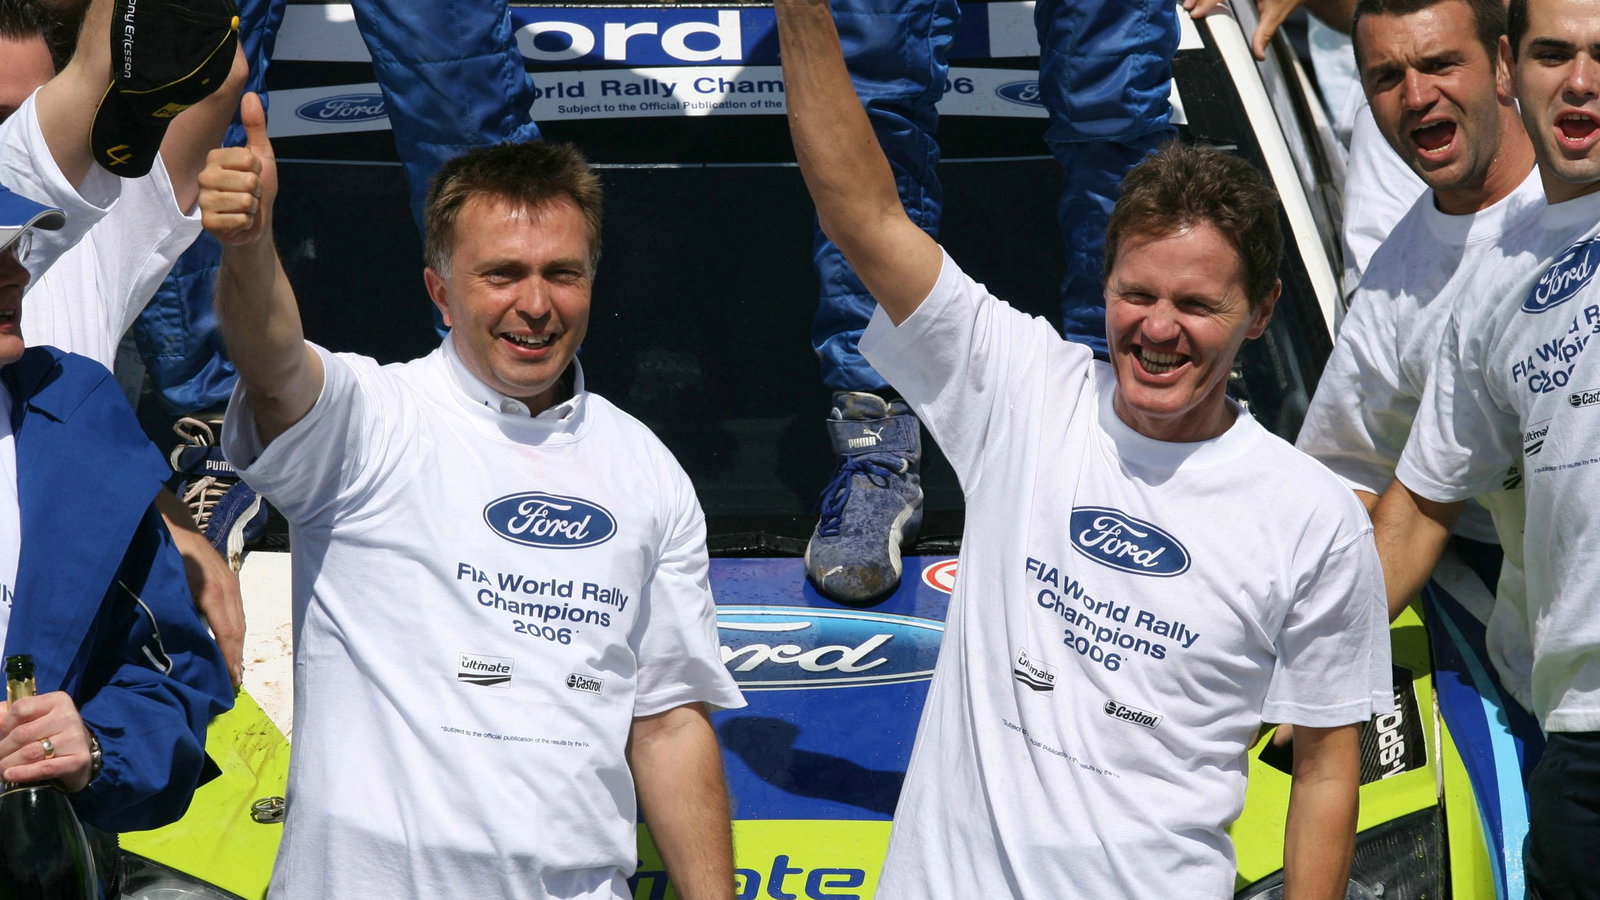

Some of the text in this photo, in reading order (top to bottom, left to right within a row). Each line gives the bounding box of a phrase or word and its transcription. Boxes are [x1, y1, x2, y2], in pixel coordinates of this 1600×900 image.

[123, 0, 137, 79] ony Ericsson
[515, 10, 743, 61] ord
[534, 81, 585, 99] orld
[601, 79, 677, 98] Rally
[693, 76, 785, 95] Cham
[319, 98, 385, 118] Ford
[558, 100, 782, 115] Subject to the Official Publication of the
[1535, 250, 1592, 305] Ford
[1512, 355, 1536, 384] FIA
[1582, 391, 1600, 405] Cast
[848, 436, 876, 449] PUMA
[507, 499, 592, 540] Ford
[1079, 516, 1166, 568] Ford
[456, 562, 629, 612] FIA World Rally
[477, 588, 611, 627] Champions
[1025, 557, 1201, 649] FIA World Rally
[1037, 589, 1167, 660] Champions
[461, 660, 511, 673] ultimate
[1018, 656, 1055, 682] ultimate
[576, 677, 602, 692] Castrol
[1115, 705, 1159, 728] Castrol
